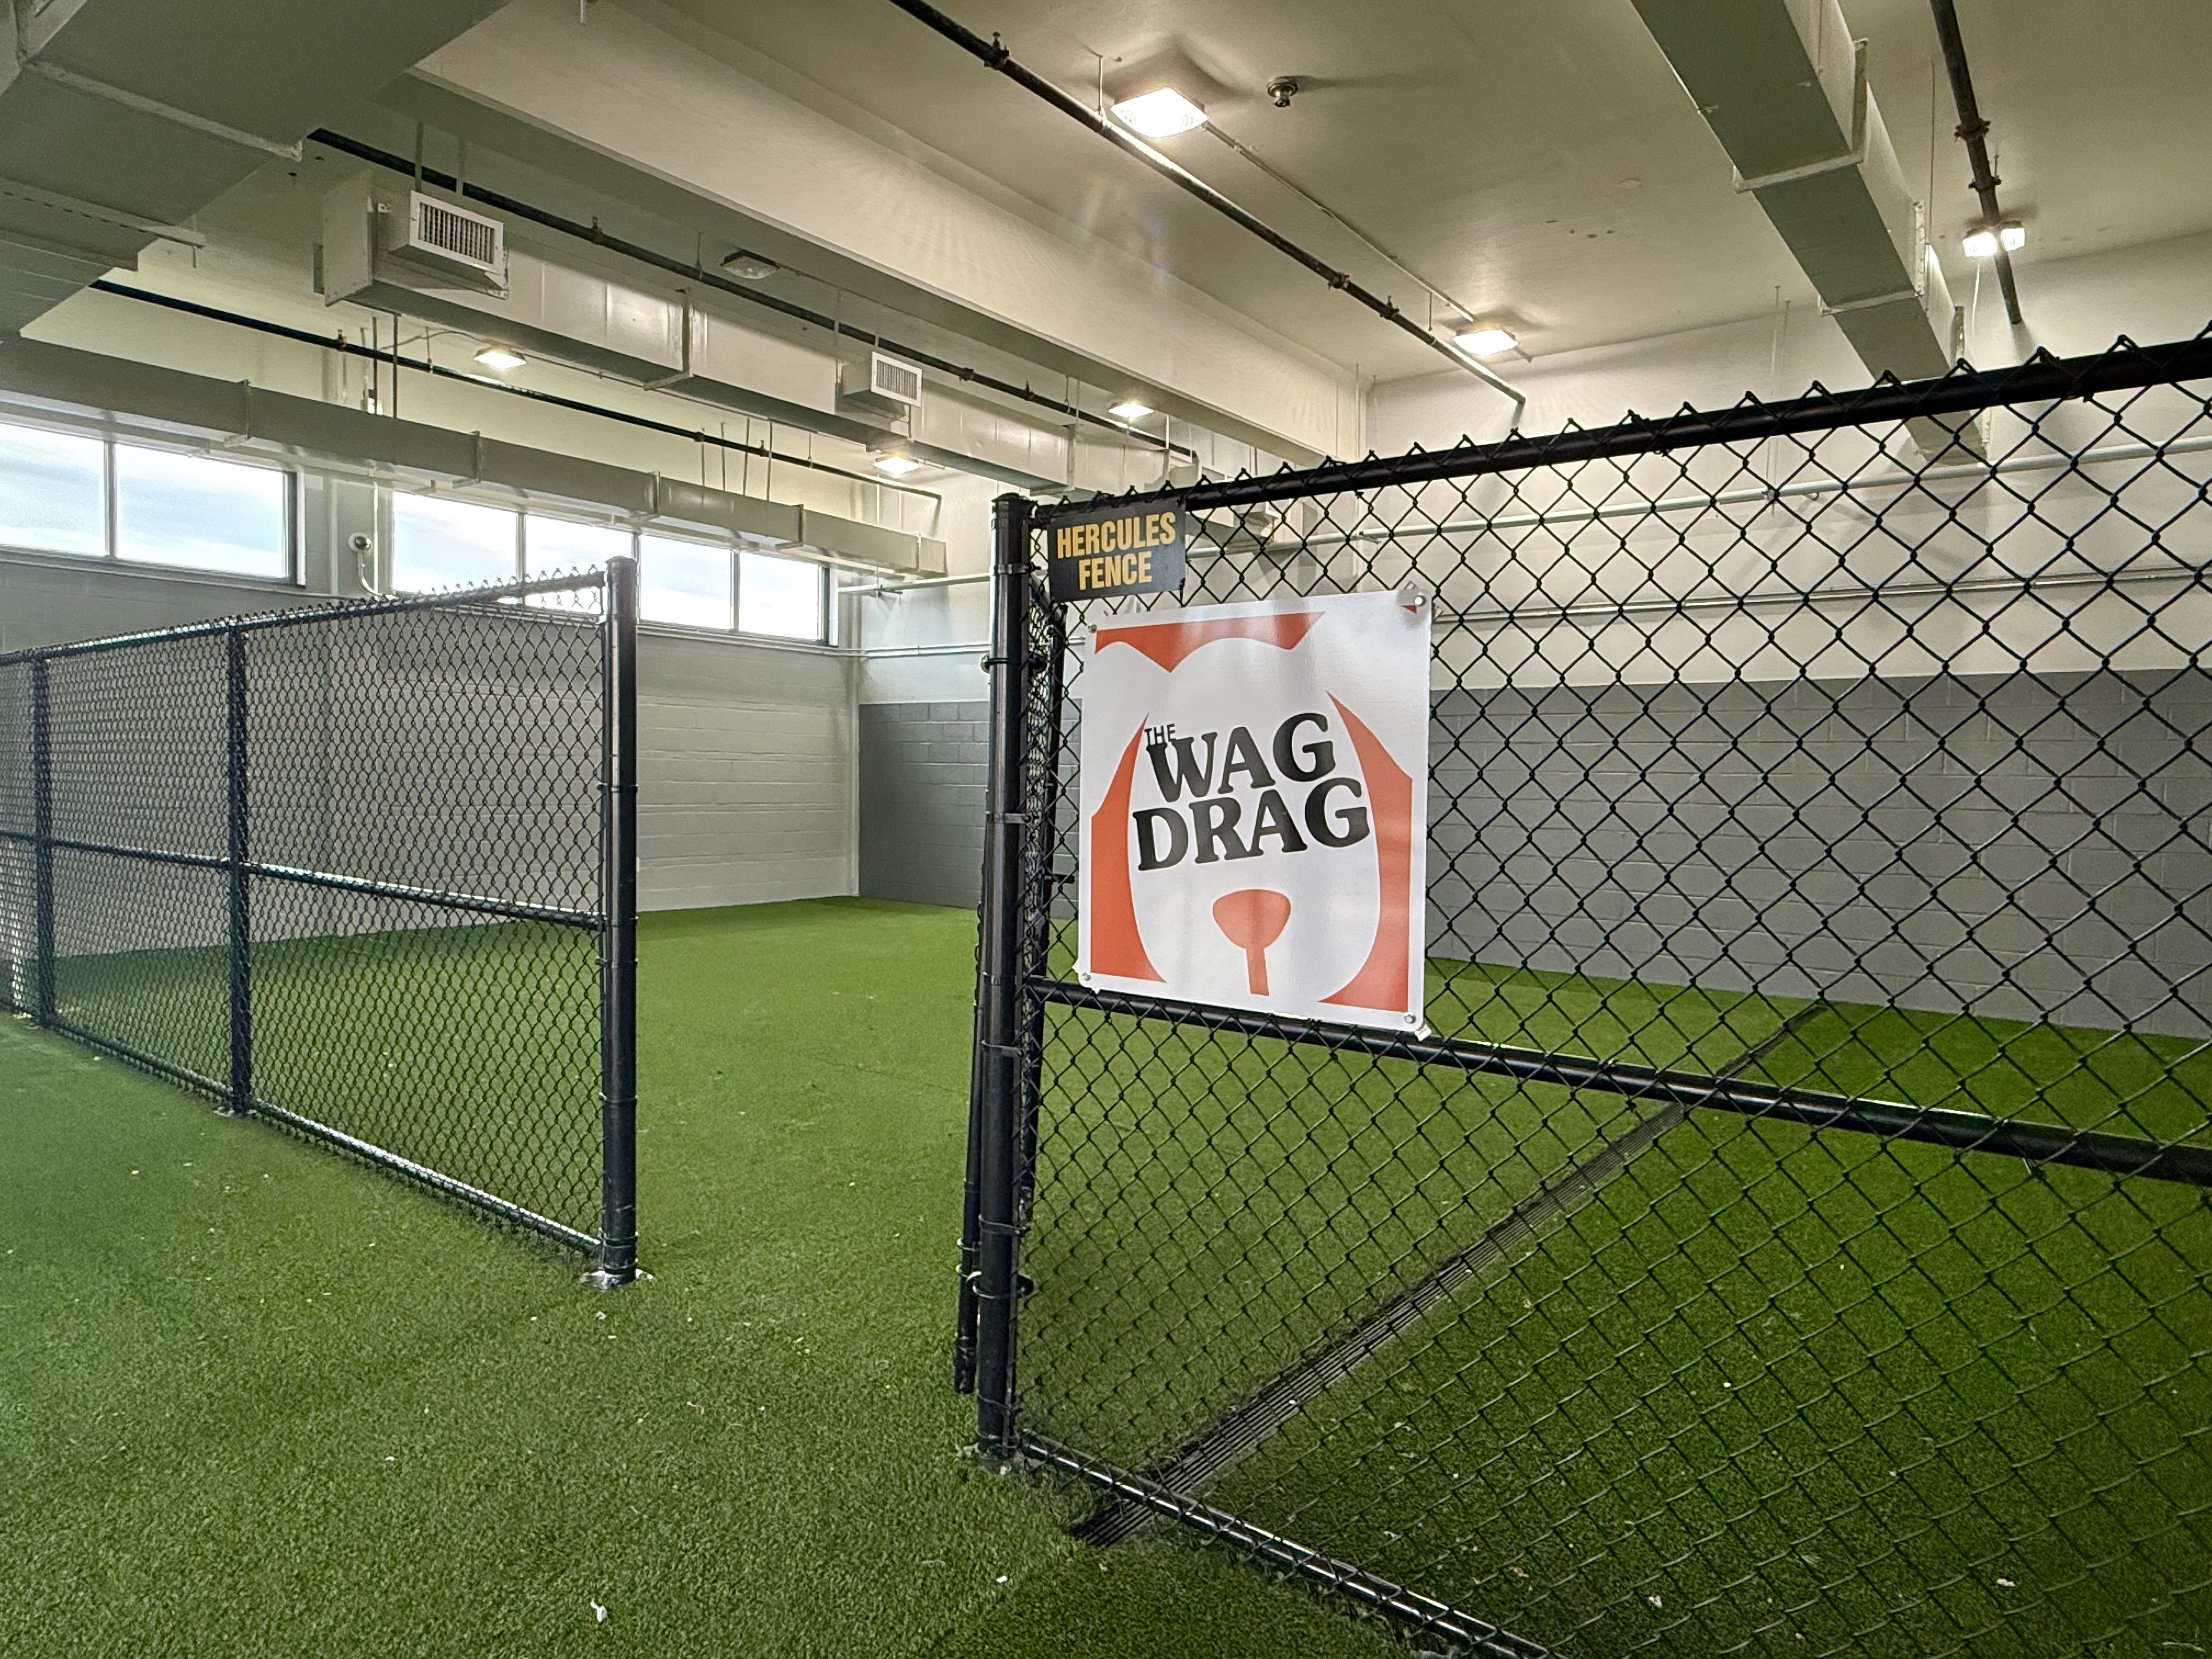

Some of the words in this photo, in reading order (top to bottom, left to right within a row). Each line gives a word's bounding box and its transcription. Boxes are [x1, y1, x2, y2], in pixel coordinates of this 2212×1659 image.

[1057, 512, 1176, 558] HERCULES
[1079, 552, 1152, 590] FENCE
[1144, 723, 1176, 746] THE
[1147, 713, 1335, 803] WAG
[1132, 777, 1370, 871] DRAG
